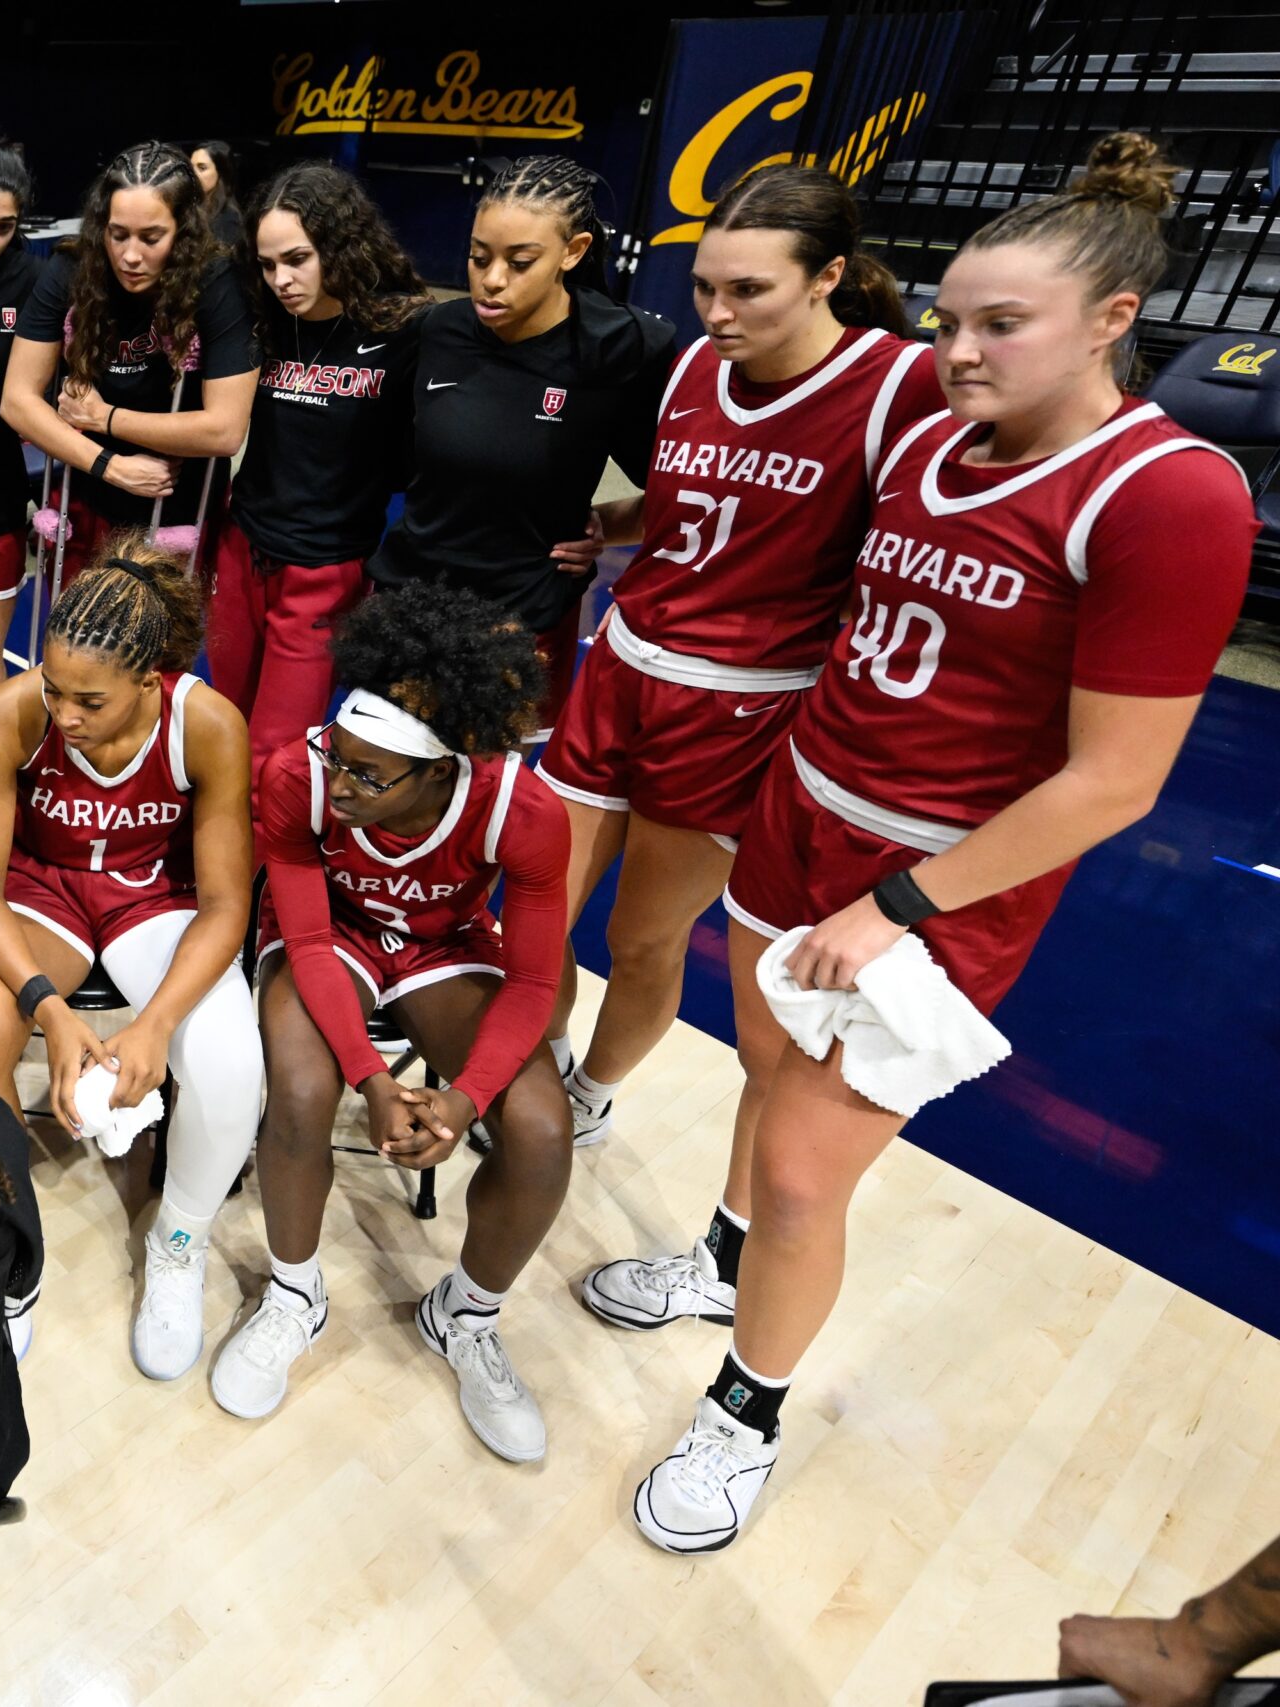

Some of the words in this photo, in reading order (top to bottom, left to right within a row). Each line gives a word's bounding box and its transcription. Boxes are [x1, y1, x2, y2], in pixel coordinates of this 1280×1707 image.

[421, 49, 578, 126] Bears
[260, 359, 385, 398] RIMSON
[1217, 342, 1277, 374] Cal
[272, 391, 329, 407] BASKETBALL
[654, 439, 824, 496] HARVARD
[652, 490, 741, 573] 31
[854, 527, 1026, 610] ARVARD
[847, 584, 947, 700] 40
[29, 786, 182, 830] HARVARD
[88, 839, 106, 872] 1
[323, 866, 467, 903] ARVAR
